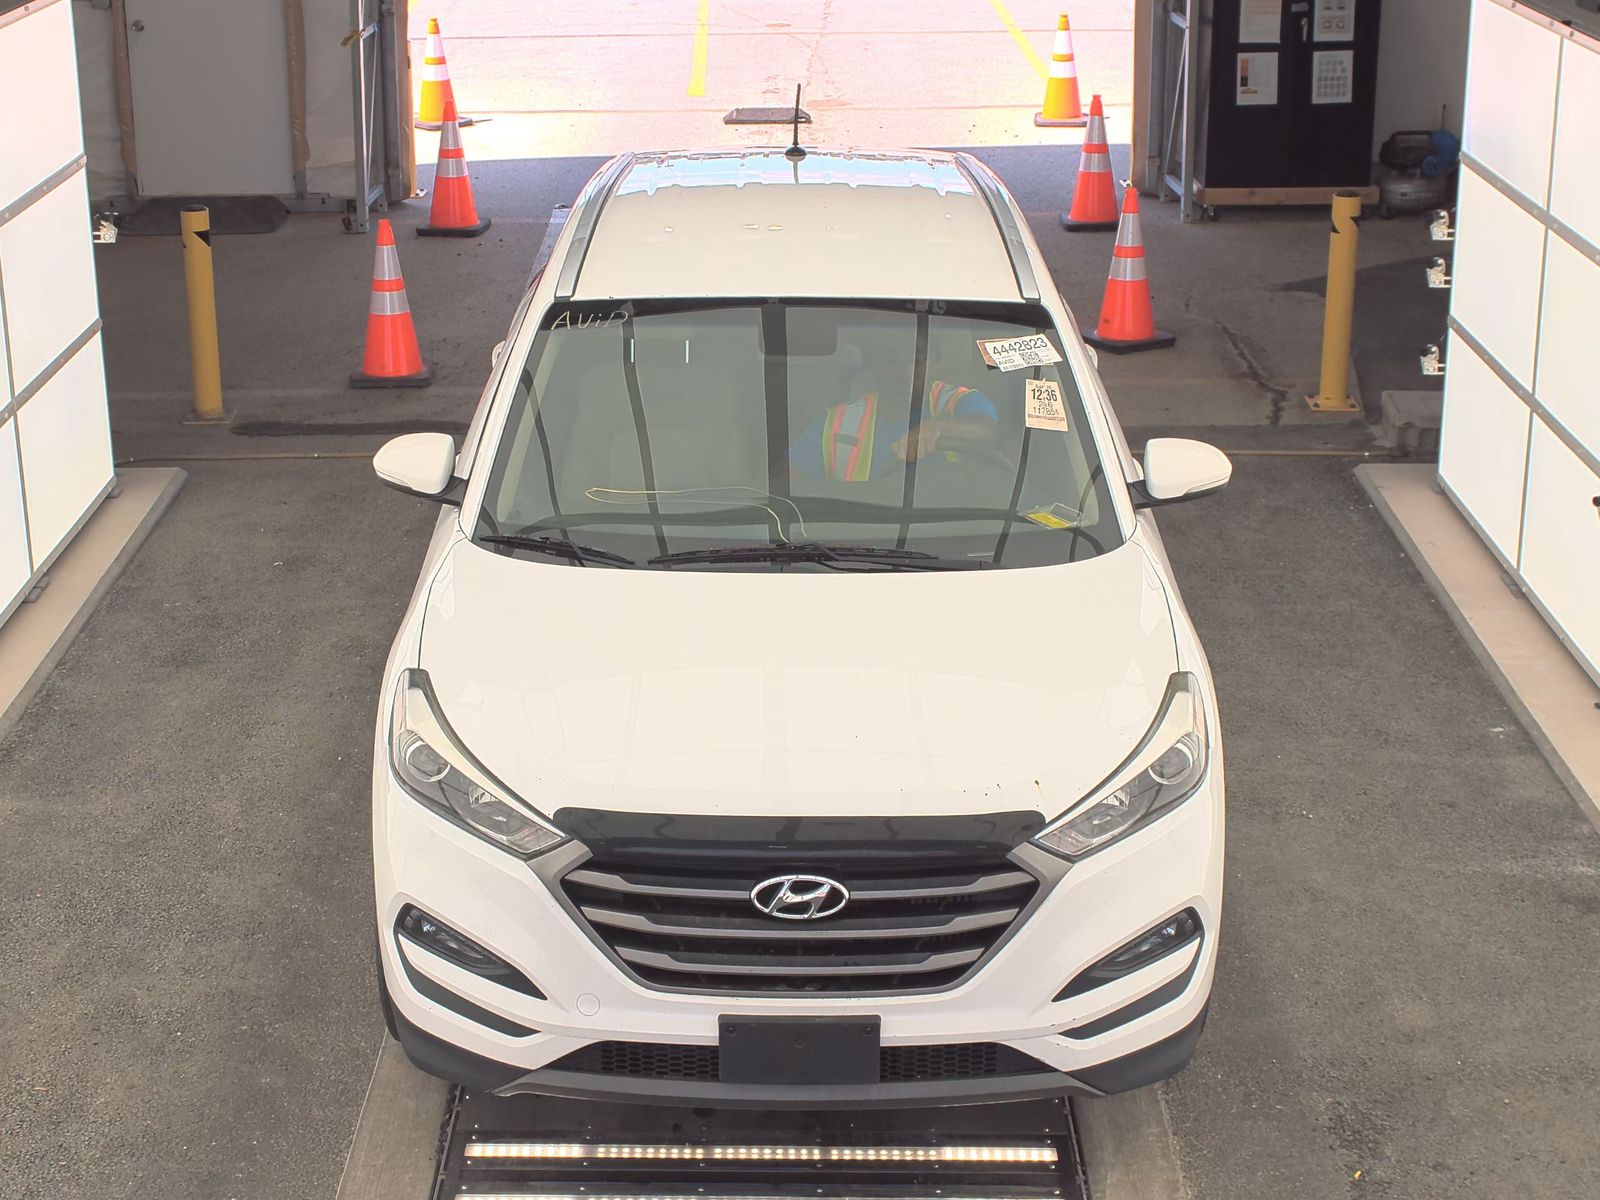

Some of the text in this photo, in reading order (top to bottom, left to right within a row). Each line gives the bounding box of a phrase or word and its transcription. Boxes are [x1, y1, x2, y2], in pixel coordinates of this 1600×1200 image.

[993, 338, 1047, 355] 4442823
[999, 358, 1014, 366] AVID
[1031, 388, 1057, 401] 12:36
